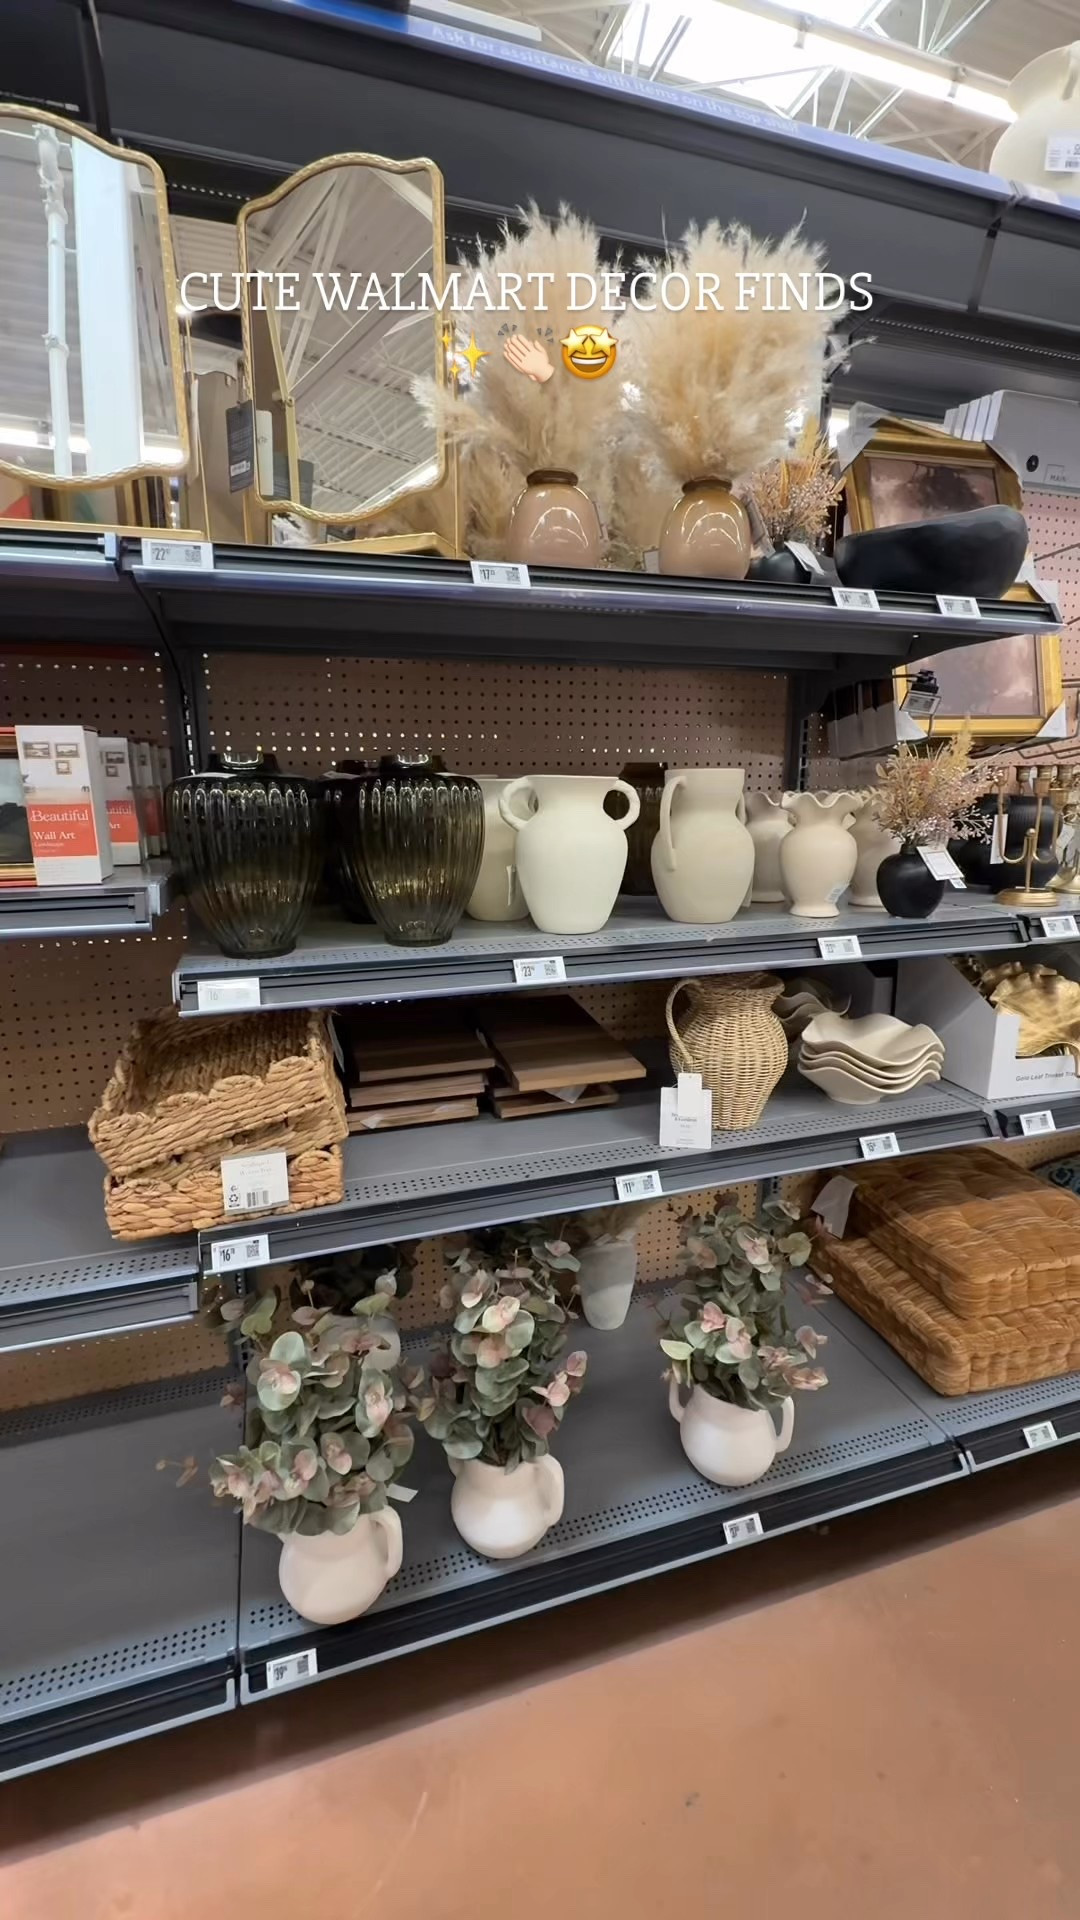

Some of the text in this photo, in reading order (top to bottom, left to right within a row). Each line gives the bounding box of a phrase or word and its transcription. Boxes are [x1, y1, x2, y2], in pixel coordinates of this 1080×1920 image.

[432, 25, 799, 135] Ask for assistance with items on the top shelf
[31, 809, 89, 822] Beautiful
[33, 831, 76, 840] Wall Art
